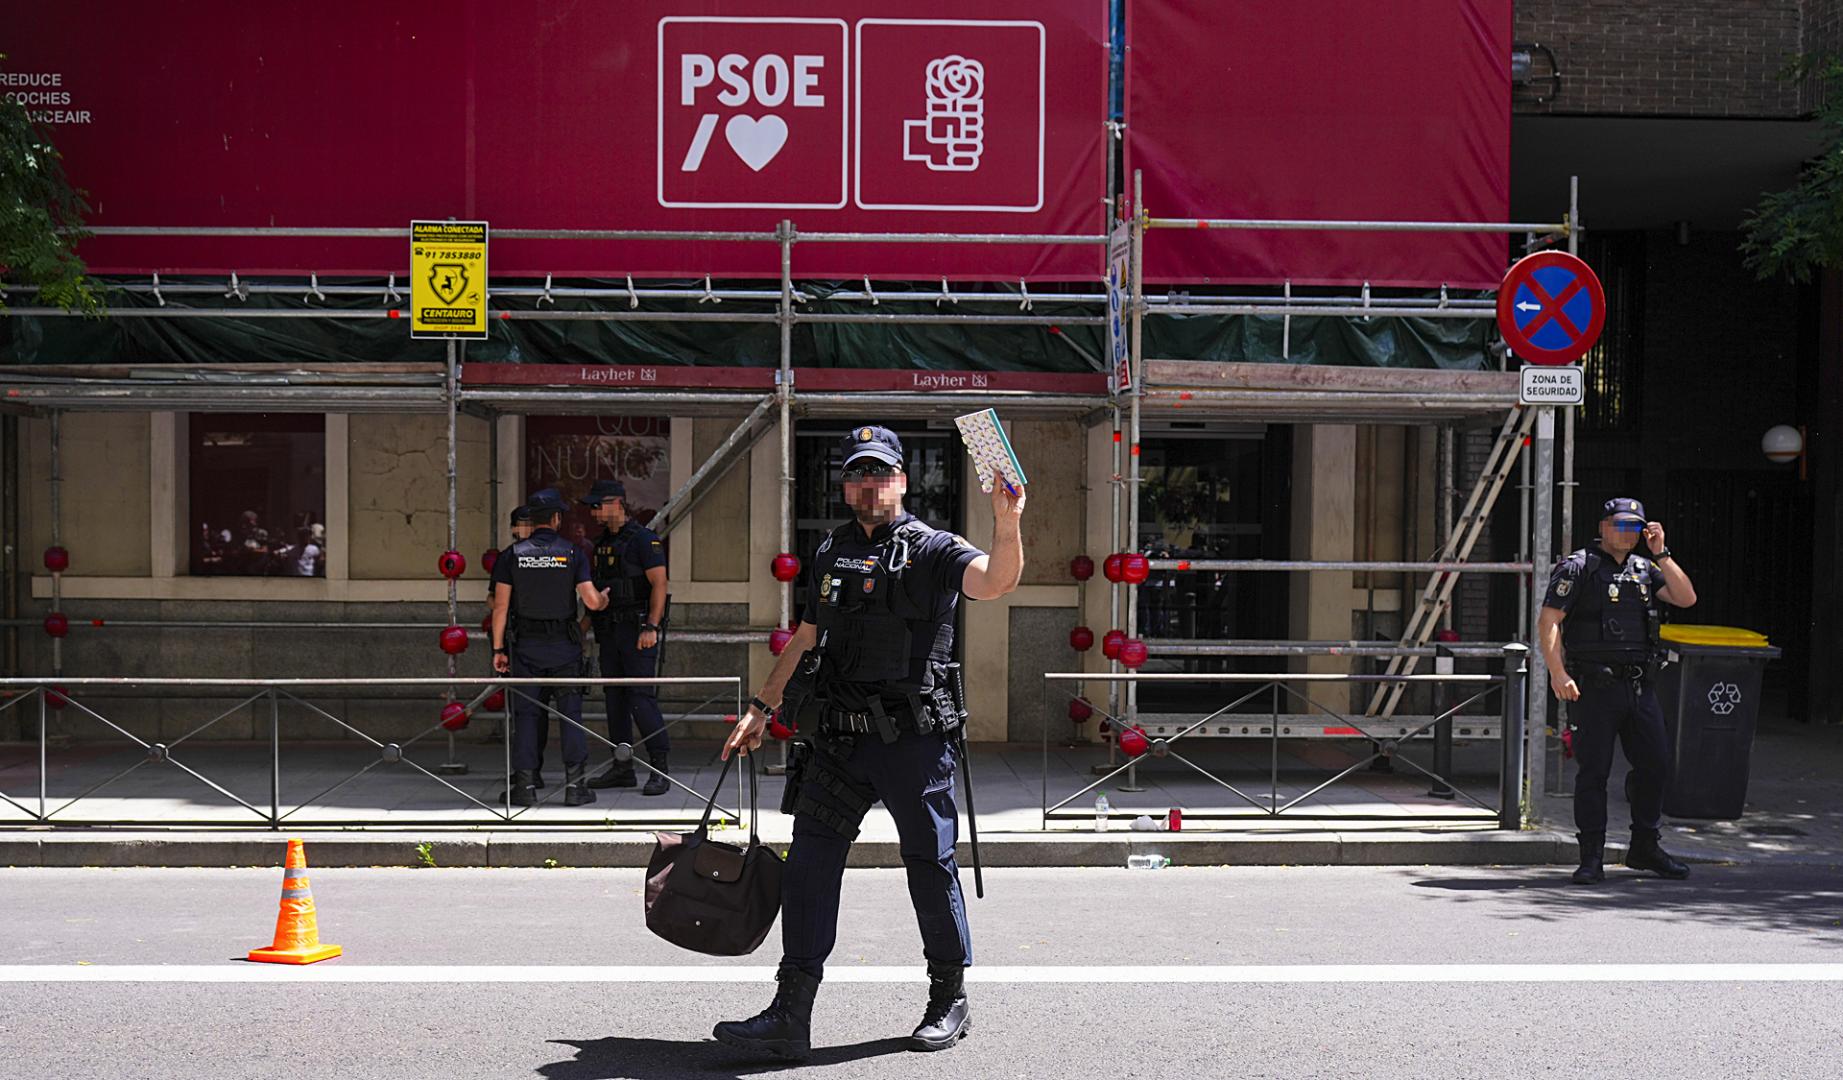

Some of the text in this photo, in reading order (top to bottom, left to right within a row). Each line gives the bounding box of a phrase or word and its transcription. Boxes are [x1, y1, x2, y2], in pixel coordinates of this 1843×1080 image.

[0, 73, 62, 86] REDUCE
[681, 53, 825, 107] PSOE
[5, 91, 71, 105] COCHES
[413, 225, 484, 234] ALARMA CONECTADA
[425, 251, 482, 260] 91 7853880
[423, 309, 474, 318] CENTAURO
[581, 367, 636, 383] Layher
[1531, 375, 1572, 384] ZONA DE
[912, 373, 967, 388] Layher
[1526, 386, 1578, 396] SEGURIDAD
[836, 557, 866, 565] POLICIA
[833, 562, 872, 571] NACIONAL
